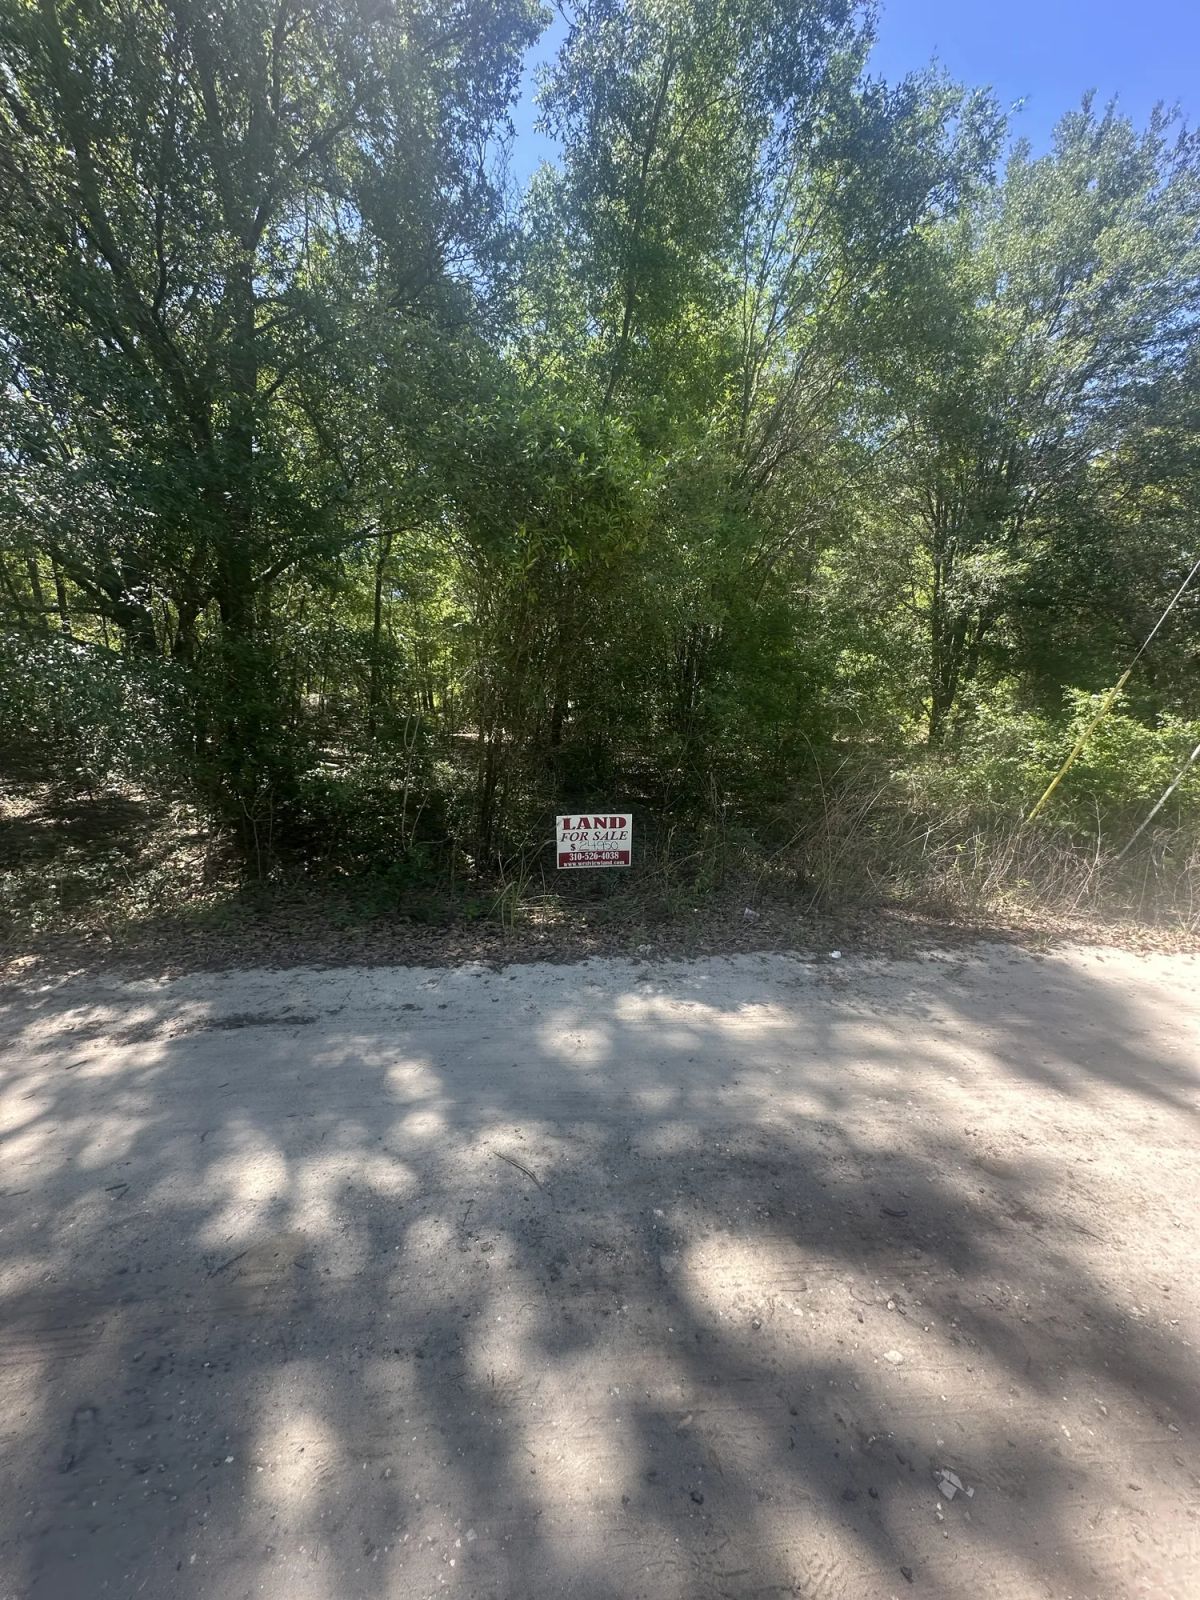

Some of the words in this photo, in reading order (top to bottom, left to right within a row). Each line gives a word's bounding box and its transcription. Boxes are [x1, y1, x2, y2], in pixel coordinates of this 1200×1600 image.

[562, 816, 627, 830] LAND
[560, 831, 588, 842] FOR
[593, 830, 629, 841] SALE
[570, 843, 576, 851] $
[569, 851, 620, 861] 310-526-4038
